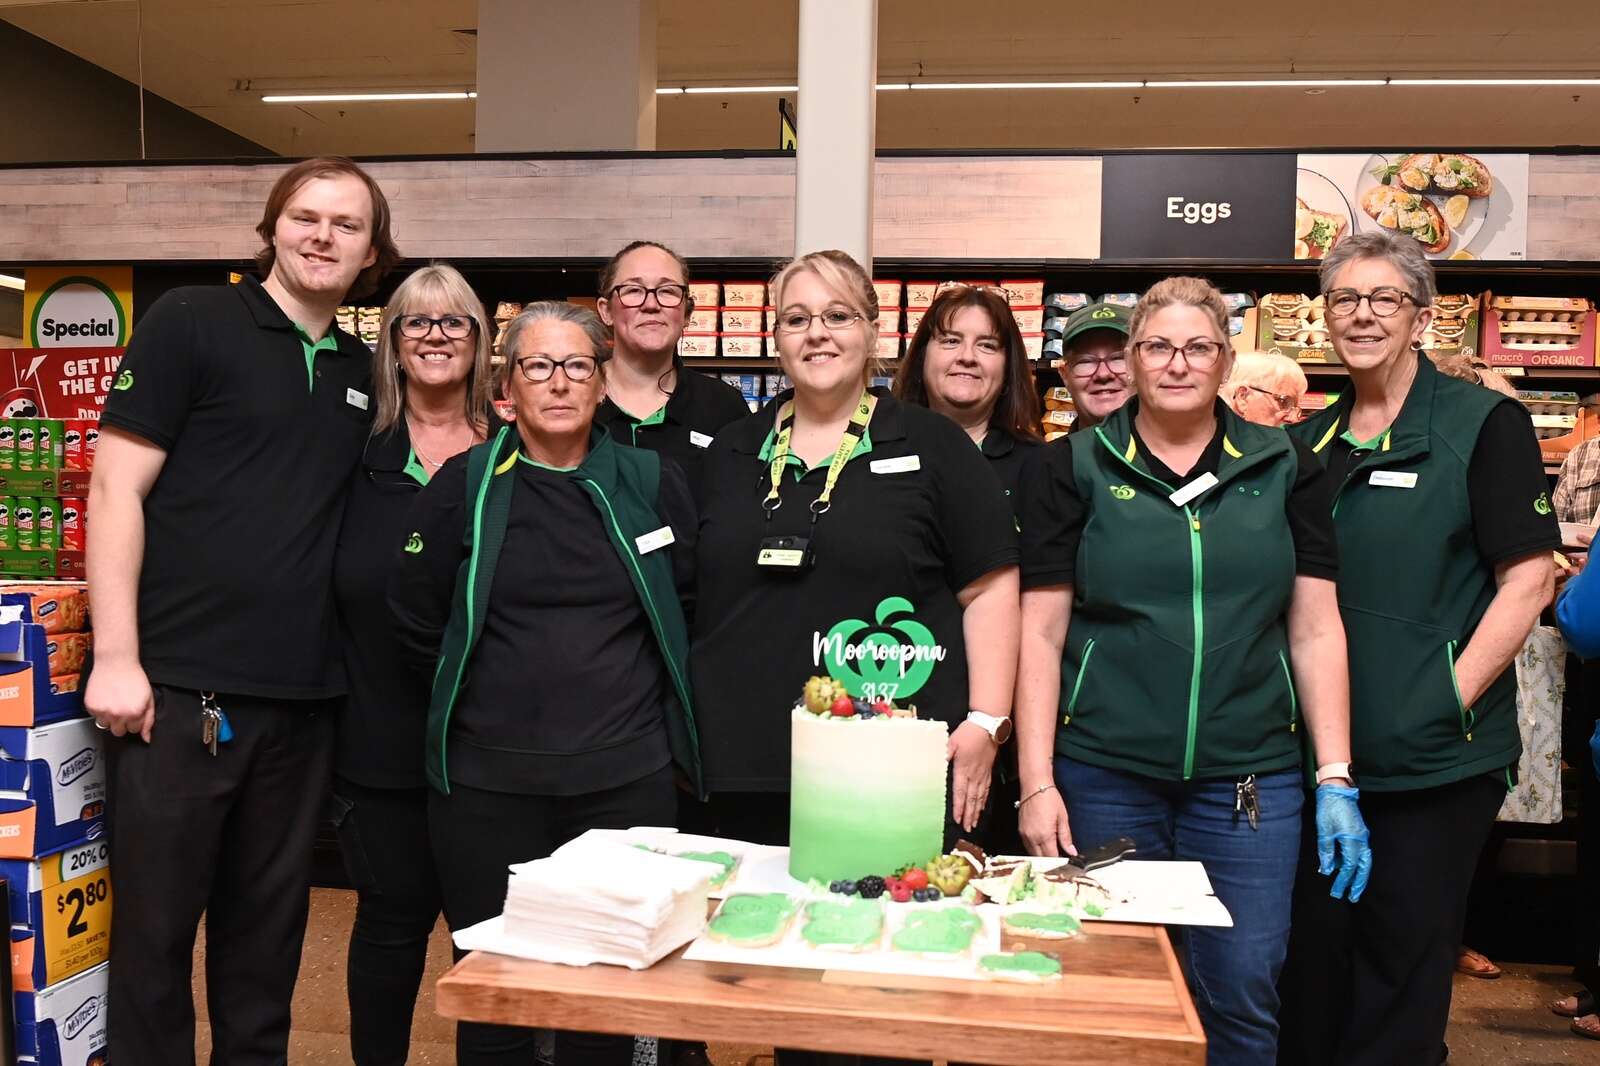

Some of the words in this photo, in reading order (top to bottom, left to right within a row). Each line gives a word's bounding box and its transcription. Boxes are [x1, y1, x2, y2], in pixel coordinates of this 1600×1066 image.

[1166, 196, 1232, 225] Eggs
[42, 318, 114, 341] Special
[63, 358, 100, 377] GET
[1492, 352, 1524, 362] macro
[1531, 355, 1585, 366] ORGANIC
[59, 377, 96, 396] THE
[101, 375, 113, 392] G
[812, 631, 947, 680] Mooroopna
[860, 682, 899, 704] 3137
[70, 848, 97, 871] 20%
[99, 843, 109, 860] O
